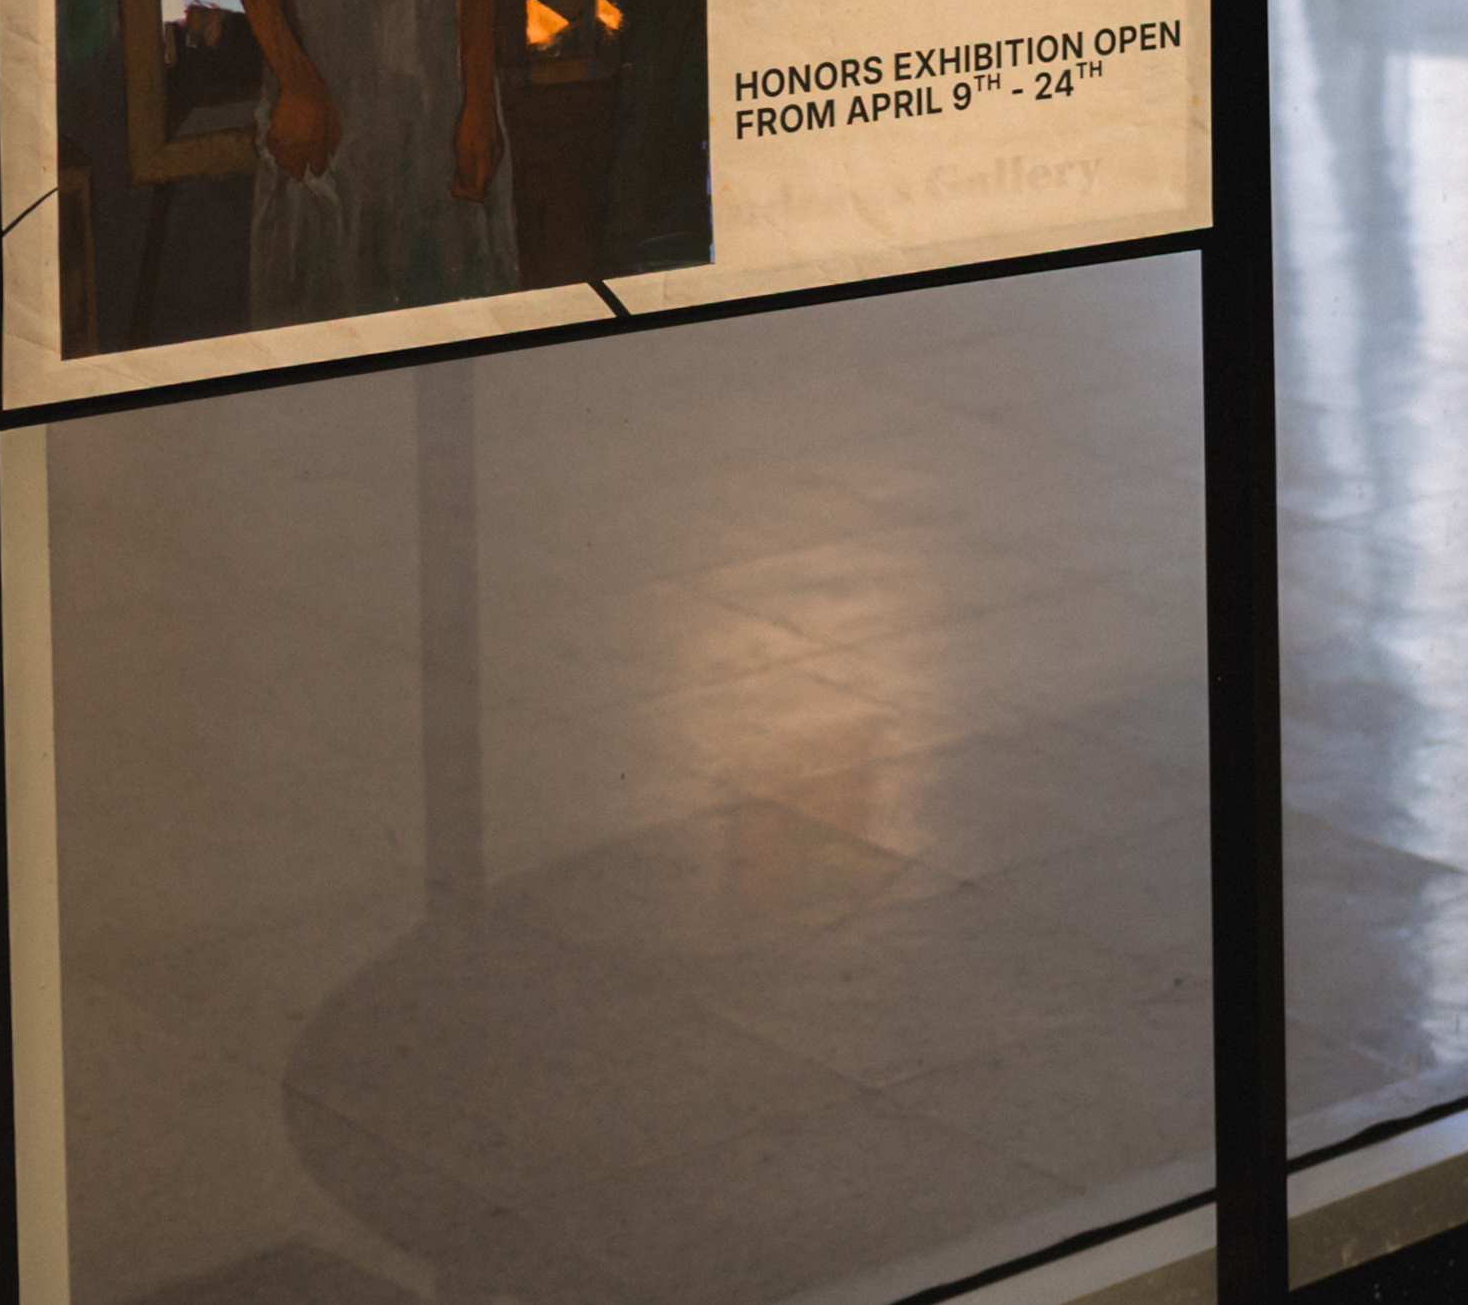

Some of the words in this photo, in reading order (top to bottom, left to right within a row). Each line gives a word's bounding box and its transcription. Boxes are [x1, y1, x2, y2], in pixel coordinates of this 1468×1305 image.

[735, 57, 883, 102] HONORS
[894, 31, 1083, 81] EXHIBITION
[1094, 20, 1181, 56] OPEN
[736, 99, 835, 140] FROM
[846, 87, 943, 125] APRIL
[953, 73, 1001, 111] 9TH
[1035, 60, 1102, 100] 24TH
